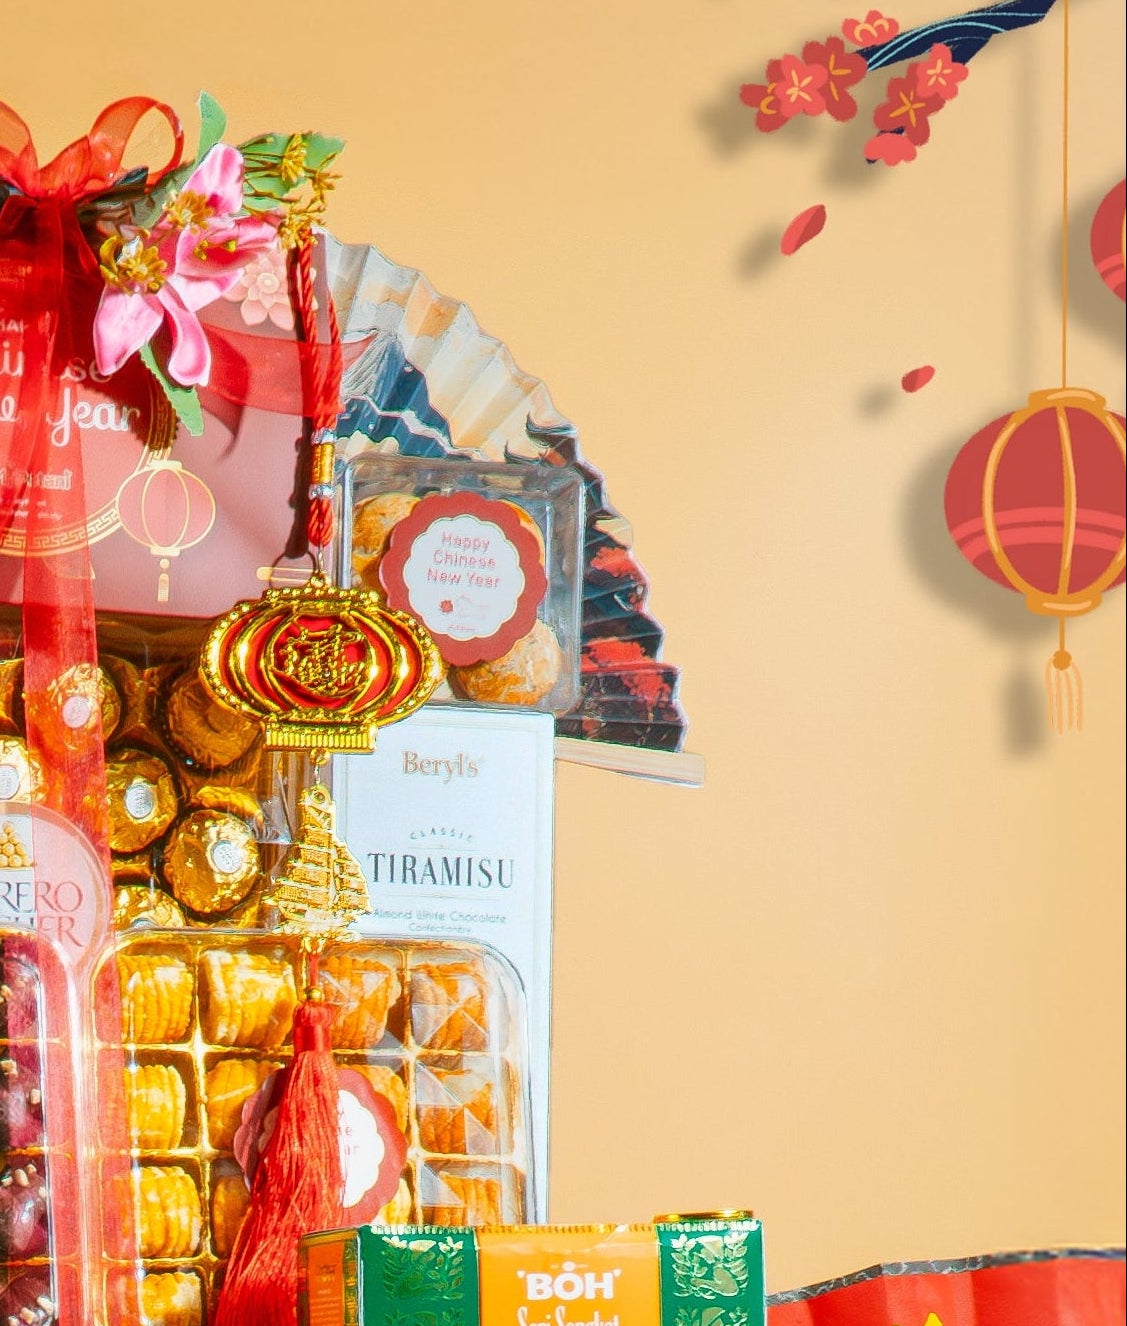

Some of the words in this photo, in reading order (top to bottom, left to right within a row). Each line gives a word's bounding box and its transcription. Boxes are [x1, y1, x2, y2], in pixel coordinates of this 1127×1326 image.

[441, 531, 490, 551] Happy
[433, 550, 496, 568] Chinese
[427, 568, 462, 584] New
[467, 571, 502, 588] Year
[402, 750, 479, 784] Beryl's
[409, 827, 473, 844] CLASSIC
[367, 853, 514, 889] TIRAMISU
